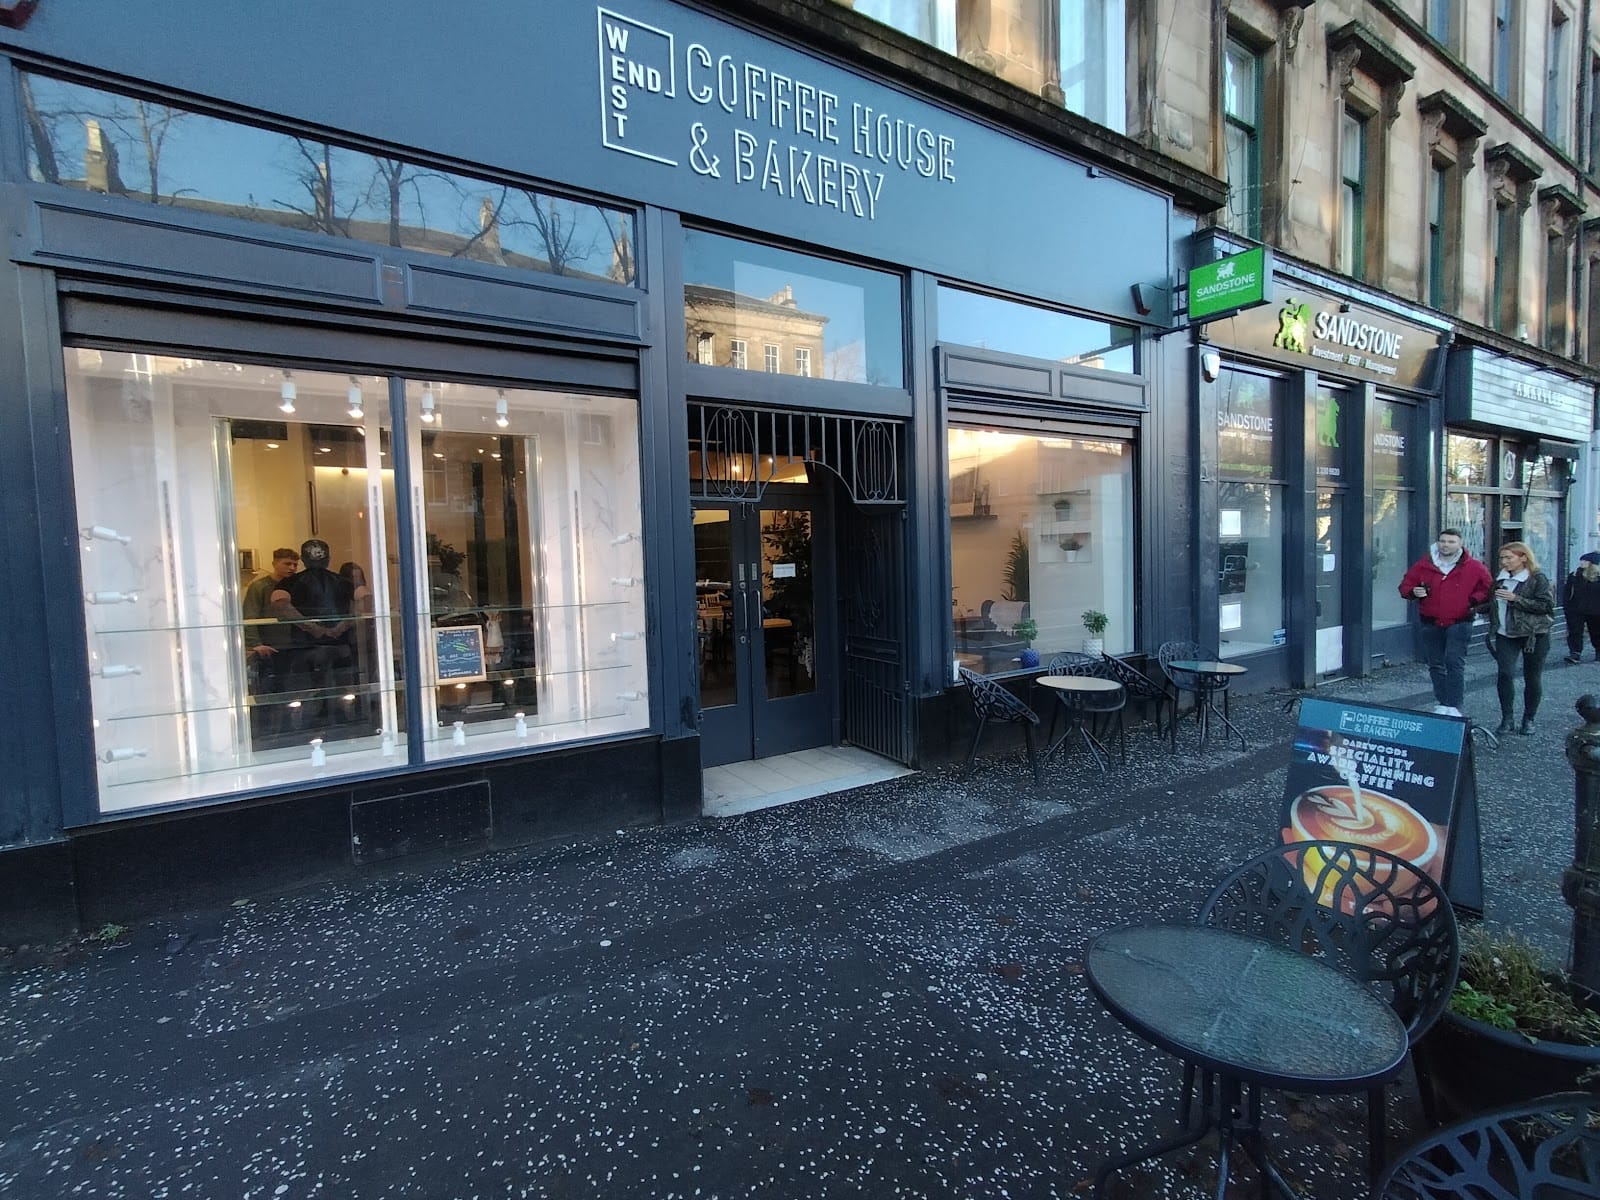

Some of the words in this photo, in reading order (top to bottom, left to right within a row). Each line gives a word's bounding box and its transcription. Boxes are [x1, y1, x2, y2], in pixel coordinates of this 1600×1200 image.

[606, 24, 629, 138] WEST
[612, 55, 662, 93] END
[687, 44, 839, 145] COFFEE
[853, 102, 956, 183] HOUSE
[690, 122, 721, 178] &
[734, 129, 885, 220] BAKERY
[1196, 272, 1256, 298] SANDSTONE
[1315, 311, 1403, 360] SANDSTONE
[1217, 410, 1273, 433] SANDSTONE
[1356, 712, 1390, 726] COFFEE
[1391, 719, 1424, 732] HOUSE
[1363, 724, 1400, 739] BAKERY
[1307, 751, 1358, 771] AWARD
[1362, 762, 1435, 787] WINNING
[1329, 745, 1415, 771] SPECIALITY
[1340, 769, 1395, 790] COFFEE
